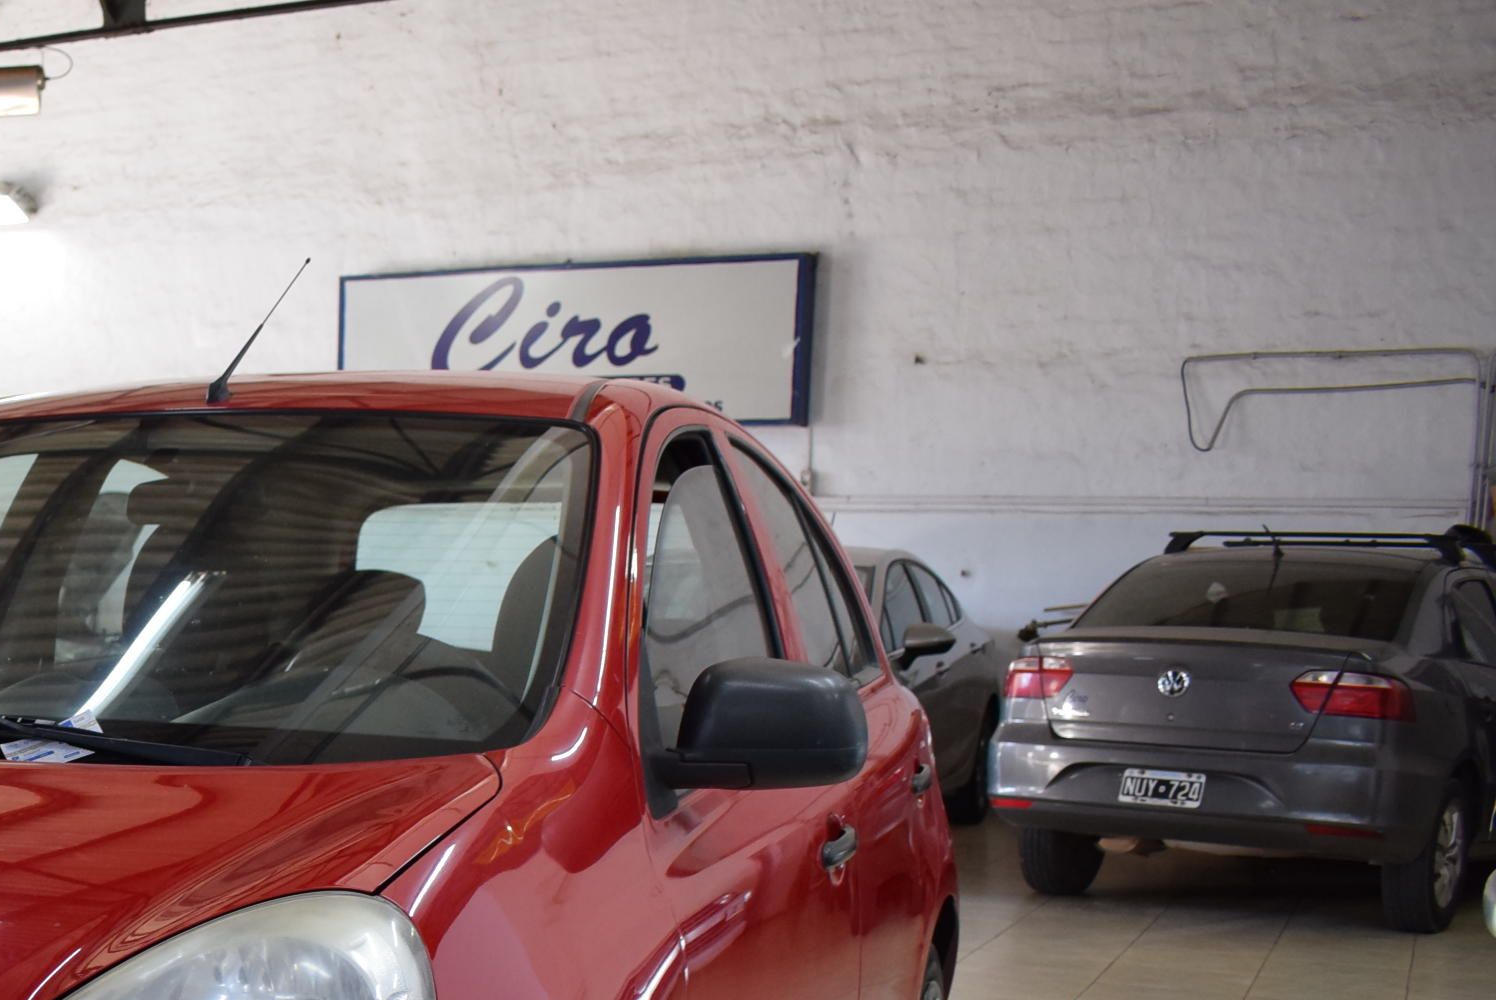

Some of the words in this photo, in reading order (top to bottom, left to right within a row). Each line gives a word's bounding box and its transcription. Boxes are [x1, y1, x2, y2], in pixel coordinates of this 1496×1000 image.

[430, 276, 660, 371] Ciro
[1123, 776, 1158, 797] NUY
[1168, 780, 1201, 801] 724
